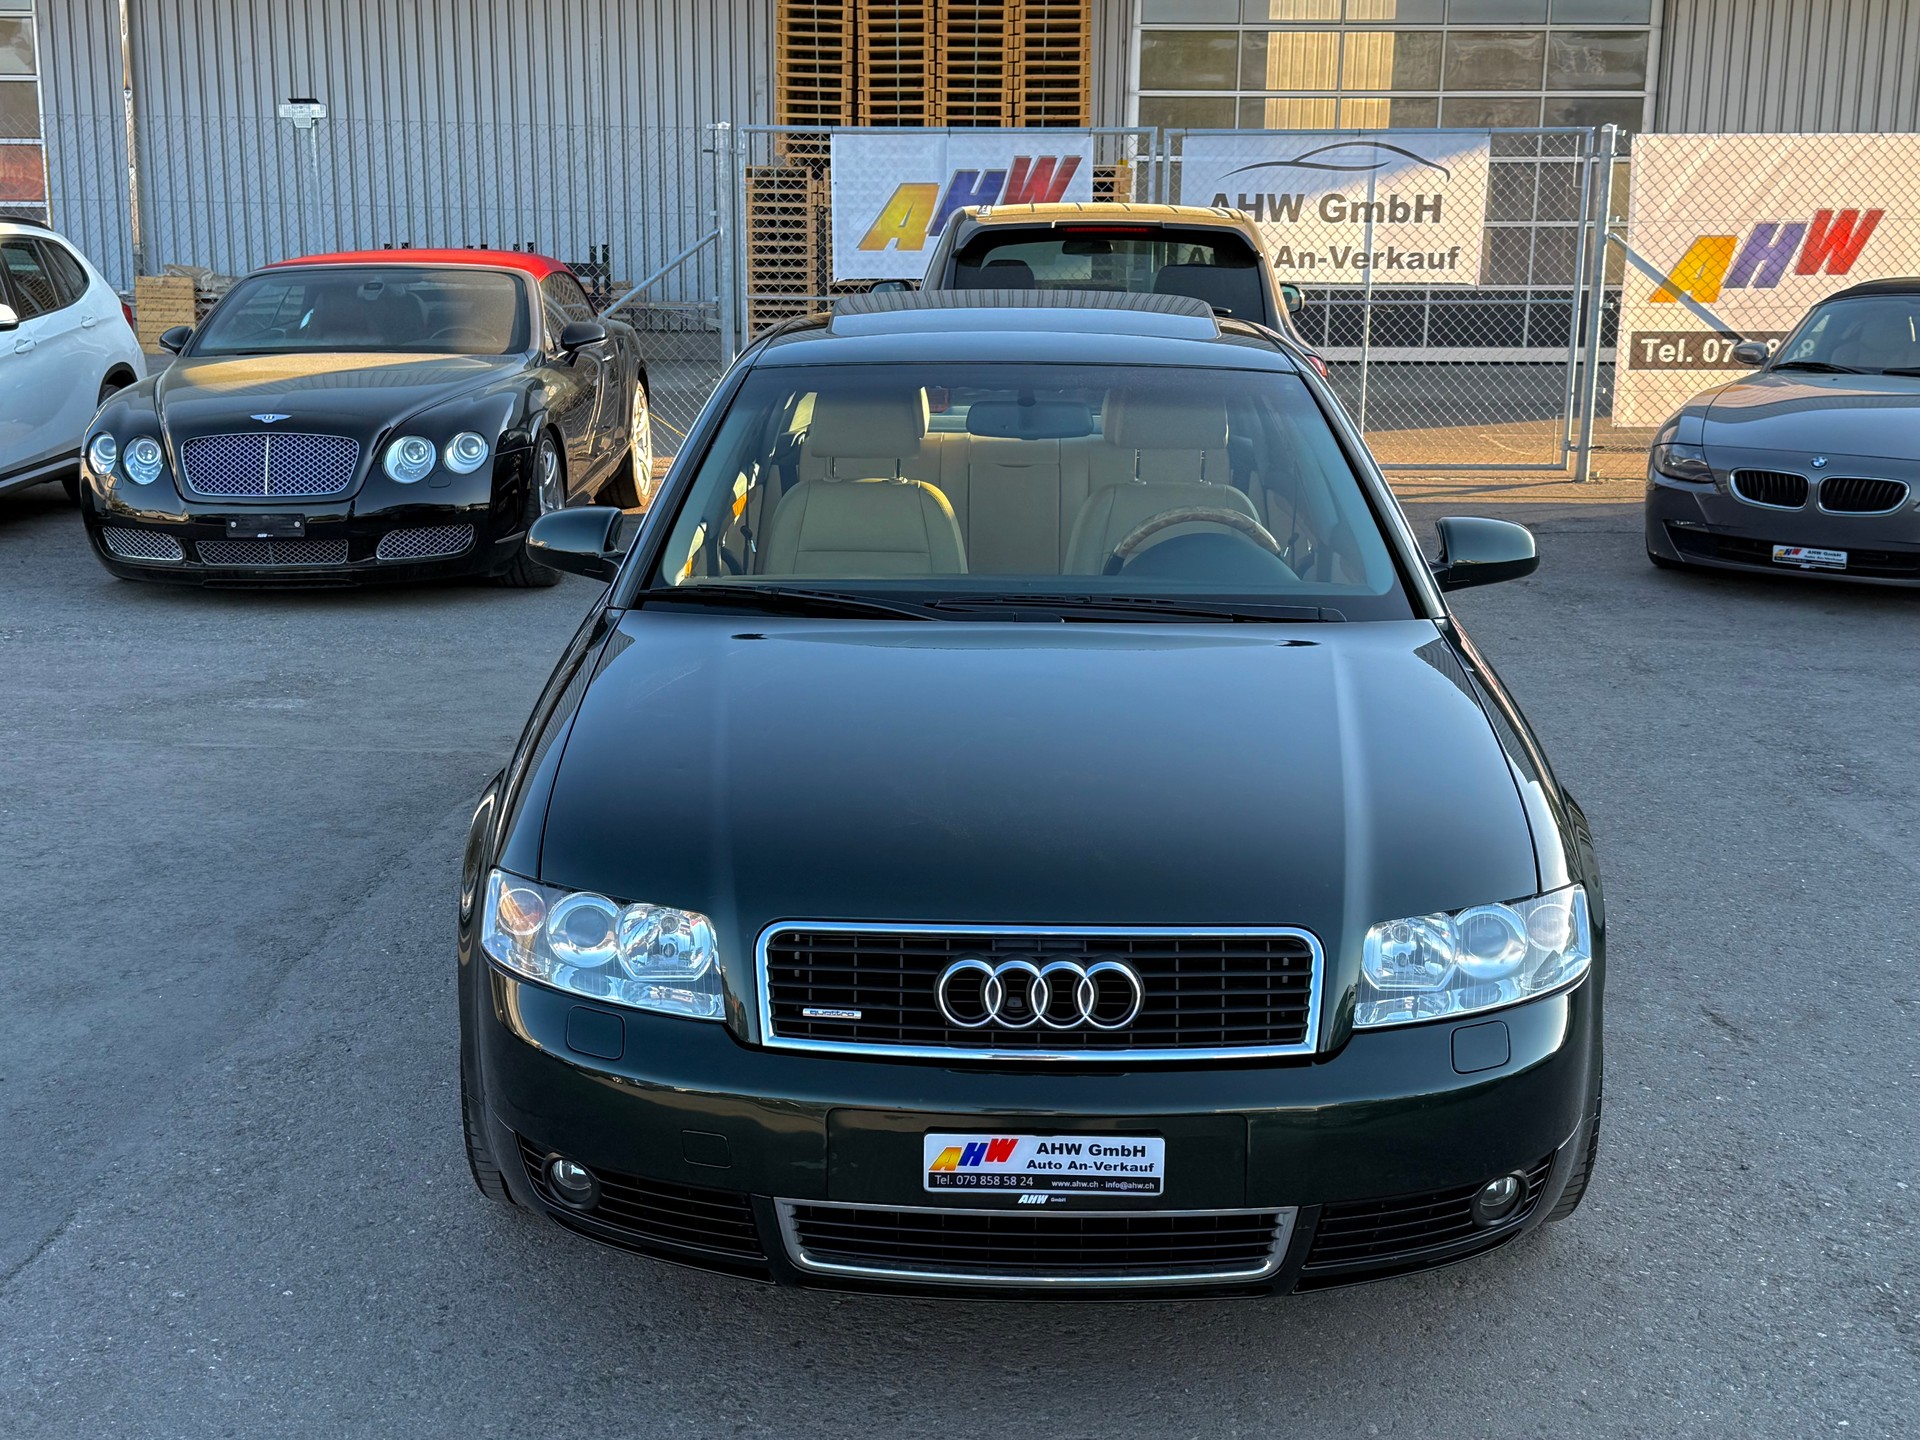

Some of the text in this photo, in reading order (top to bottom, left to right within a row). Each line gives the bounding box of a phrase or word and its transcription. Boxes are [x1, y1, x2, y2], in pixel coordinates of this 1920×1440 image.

[856, 155, 1083, 252] AHW
[1318, 193, 1443, 224] GmbH
[1274, 246, 1462, 271] An-Verkauf
[1647, 208, 1886, 304] AHW
[1641, 338, 1693, 363] Tel.
[1703, 338, 1752, 363] 07
[929, 1138, 1019, 1172] AHW
[1036, 1142, 1147, 1158] AHW GmbH
[1026, 1159, 1155, 1173] Auto An-Verkauf
[934, 1174, 1034, 1187] Tel. 079 858 58 24
[1051, 1179, 1099, 1189] www.ahw.ch
[1105, 1180, 1155, 1190] info@ahw.ch
[1017, 1194, 1049, 1205] AHW
